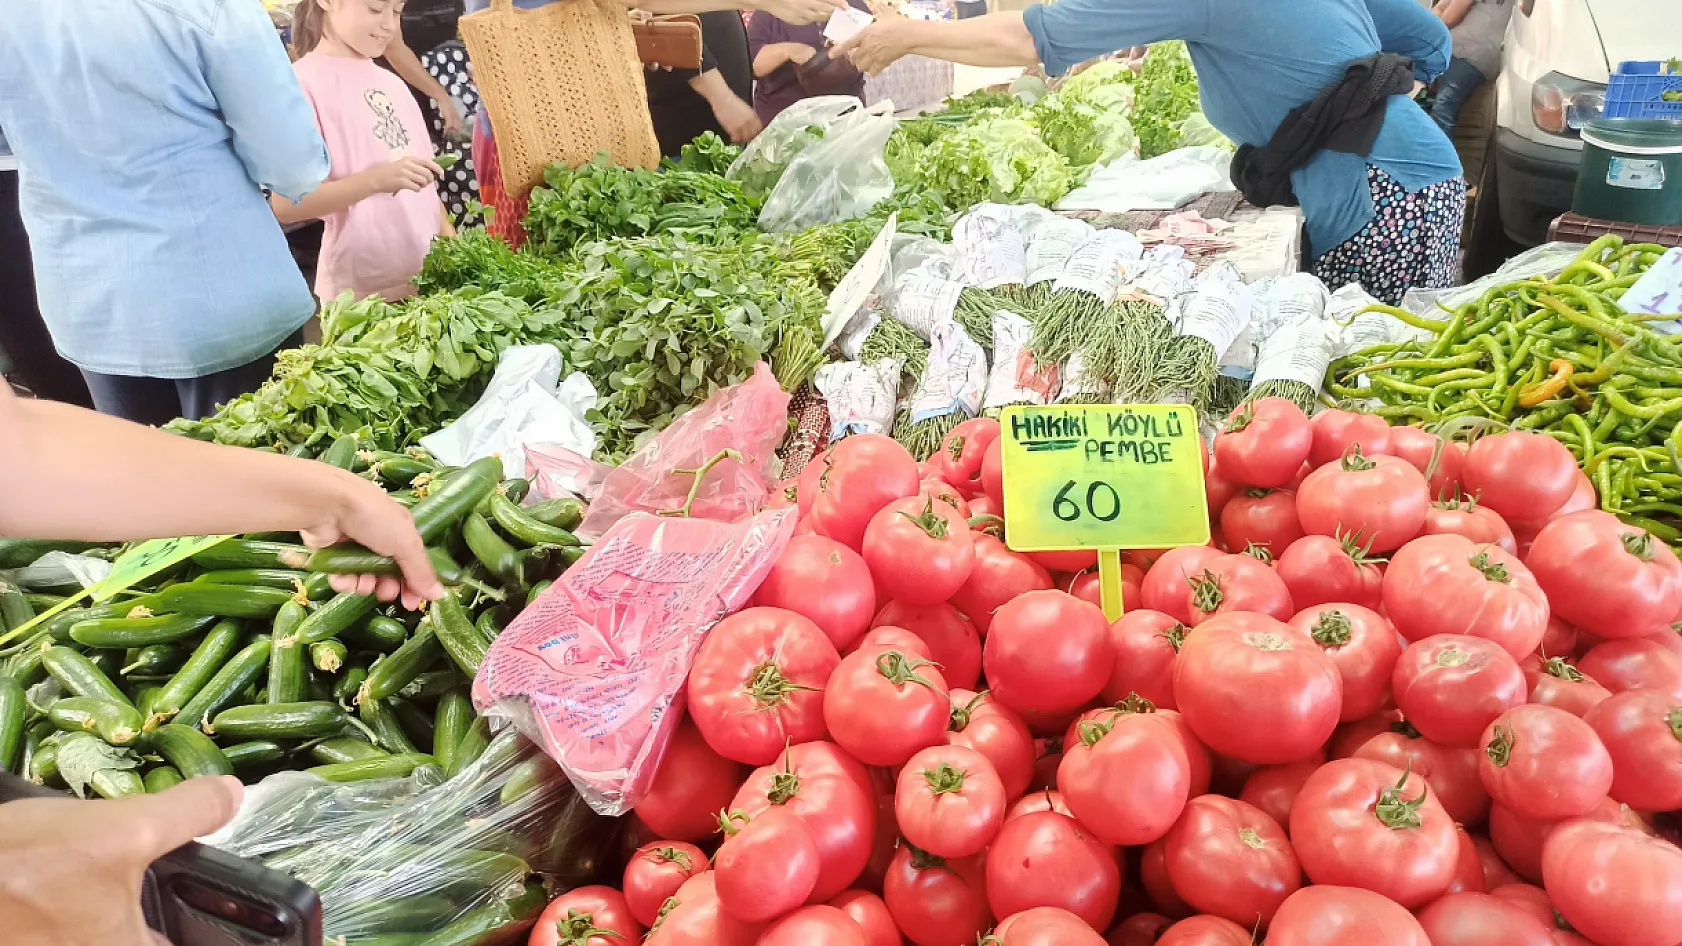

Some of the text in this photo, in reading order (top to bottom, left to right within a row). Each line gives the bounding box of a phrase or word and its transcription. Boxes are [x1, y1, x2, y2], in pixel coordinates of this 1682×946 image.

[1106, 409, 1183, 438] KÖYLÜ
[1084, 439, 1173, 464] PEMBE
[1052, 479, 1121, 522] 60
